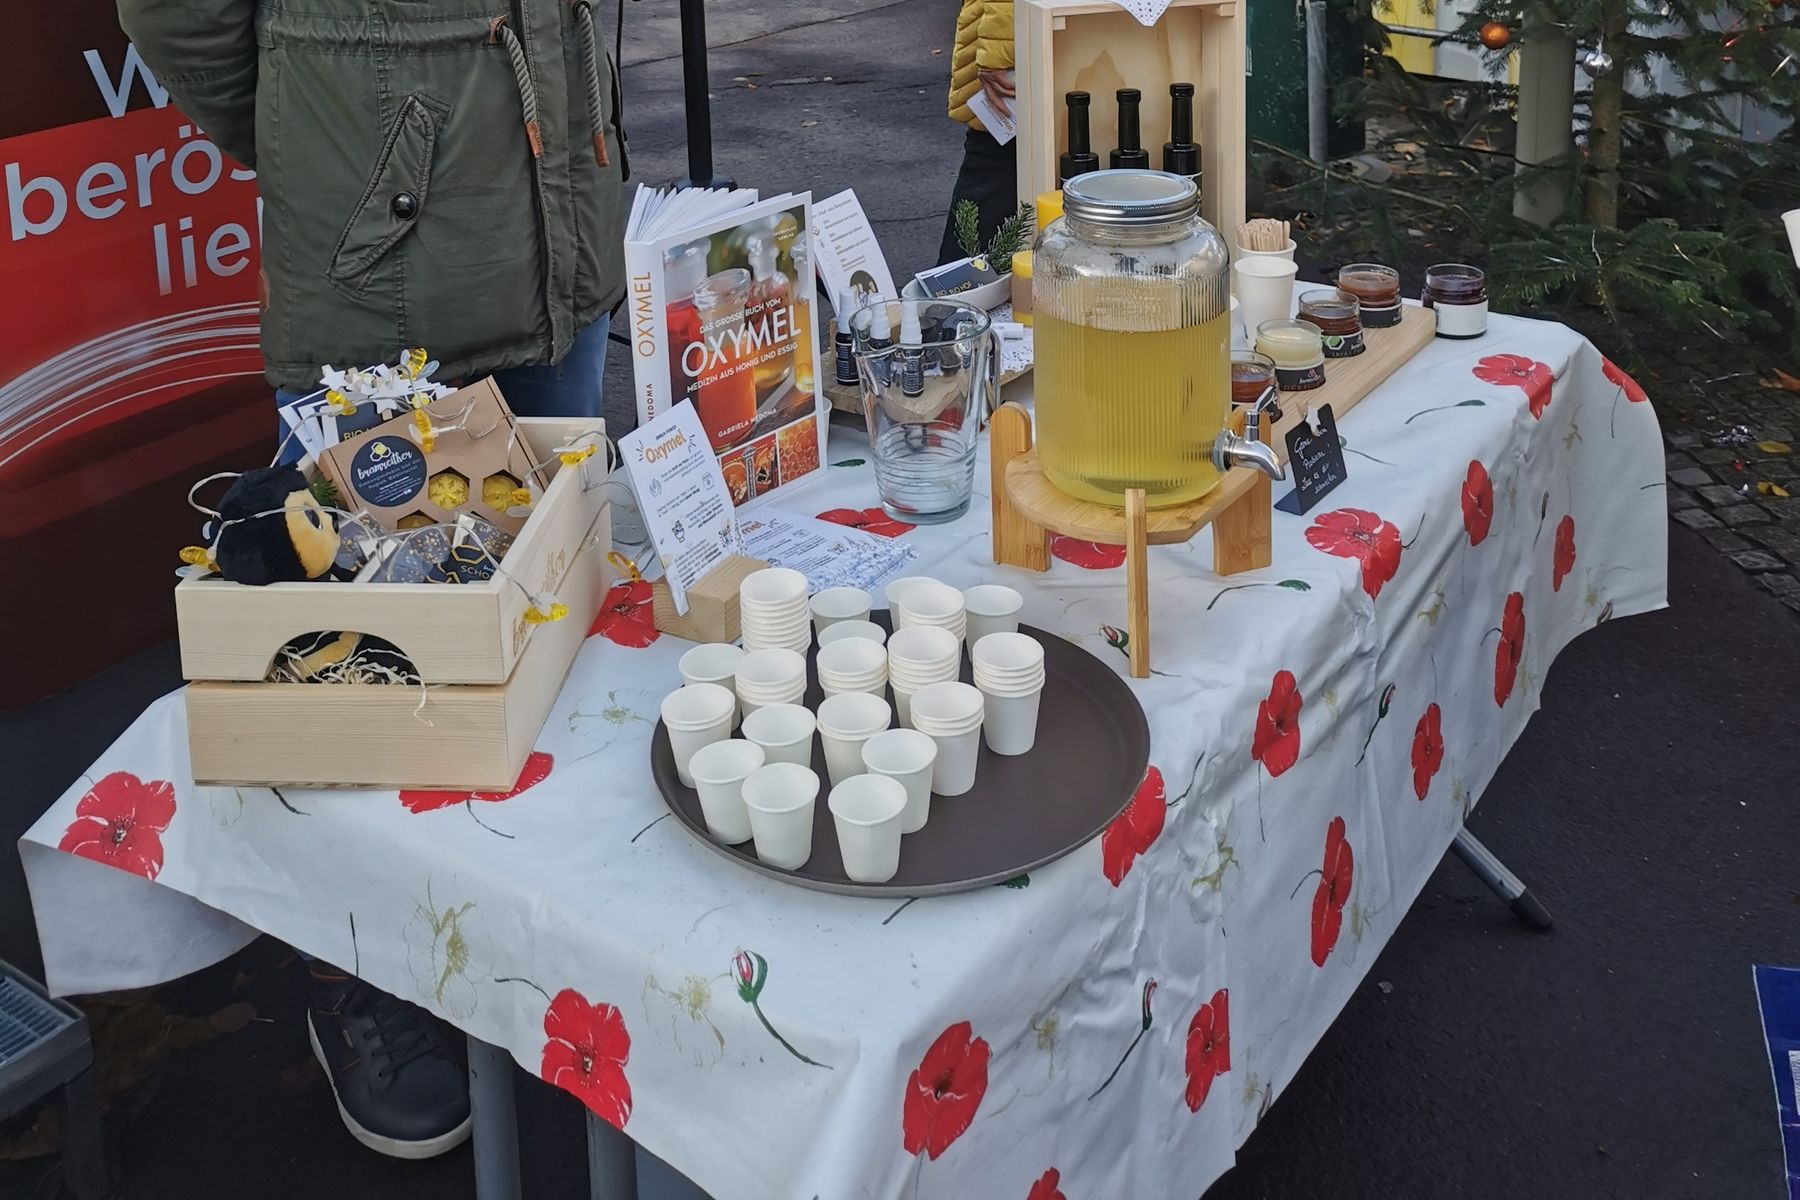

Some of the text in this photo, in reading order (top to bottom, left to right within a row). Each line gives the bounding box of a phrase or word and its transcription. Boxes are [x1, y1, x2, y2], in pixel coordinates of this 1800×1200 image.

[154, 196, 264, 296] lie
[633, 272, 656, 358] OXYMEL
[681, 304, 802, 378] OXYMEL
[700, 298, 781, 334] DAS GROSSE BUCH VOM
[687, 341, 798, 393] MEDIZIN AUS HONIG UND ESSIG
[645, 428, 687, 464] Oxymel
[718, 418, 749, 438] GABRIELA
